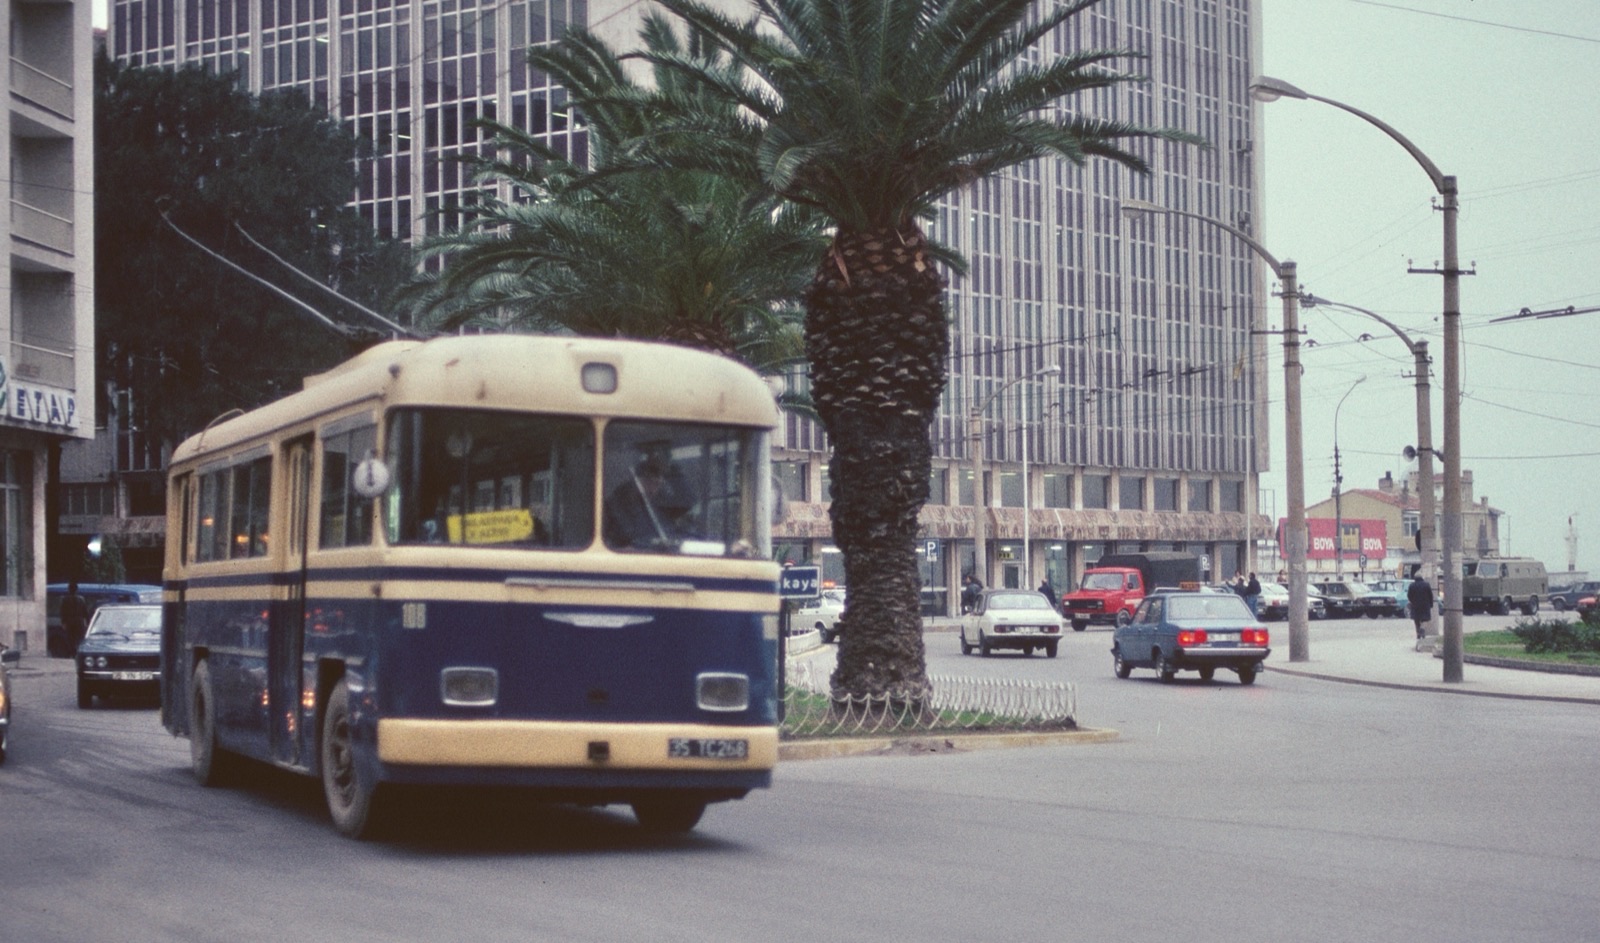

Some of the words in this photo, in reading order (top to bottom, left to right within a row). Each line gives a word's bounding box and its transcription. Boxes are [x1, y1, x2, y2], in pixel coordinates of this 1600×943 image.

[16, 388, 76, 424] ETAP
[927, 541, 936, 555] P
[1313, 537, 1335, 551] BOYA
[1363, 538, 1383, 551] BOYA
